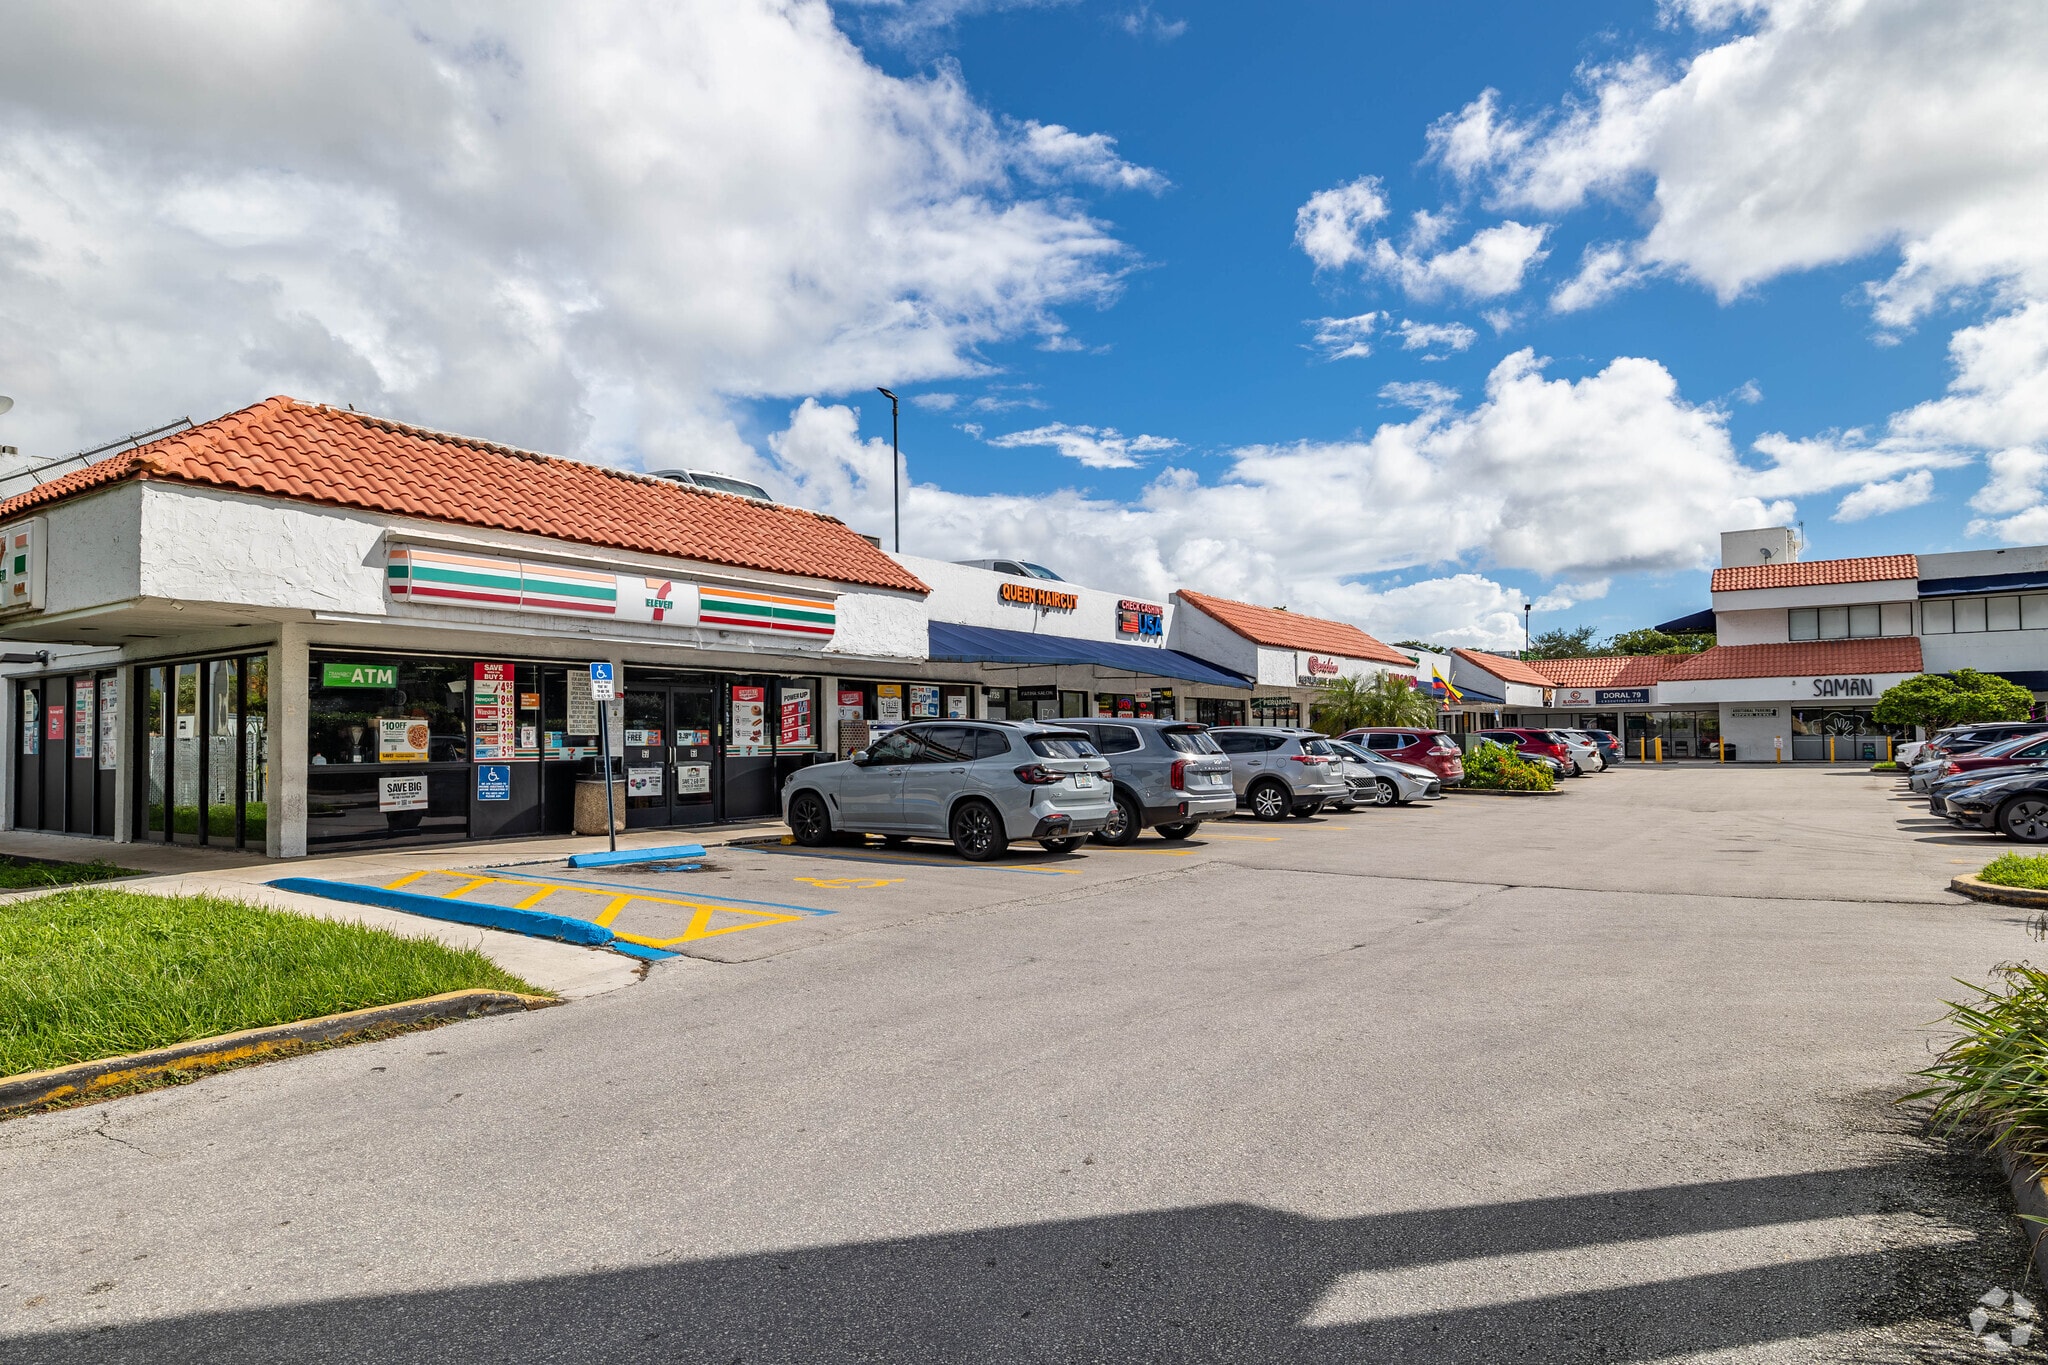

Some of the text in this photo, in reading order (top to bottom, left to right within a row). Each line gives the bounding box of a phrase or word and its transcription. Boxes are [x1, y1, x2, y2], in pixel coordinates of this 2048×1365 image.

[1002, 583, 1079, 610] QUEEN HAIRCUT
[1121, 600, 1163, 616] CHECK CASHING
[1138, 614, 1163, 636] USA
[484, 664, 504, 672] SAVE
[351, 668, 393, 685] ATM
[783, 691, 808, 702] POWER UP
[382, 721, 407, 730] $10 OFF
[627, 734, 642, 742] FREE
[387, 781, 422, 793] SAVE BIG
